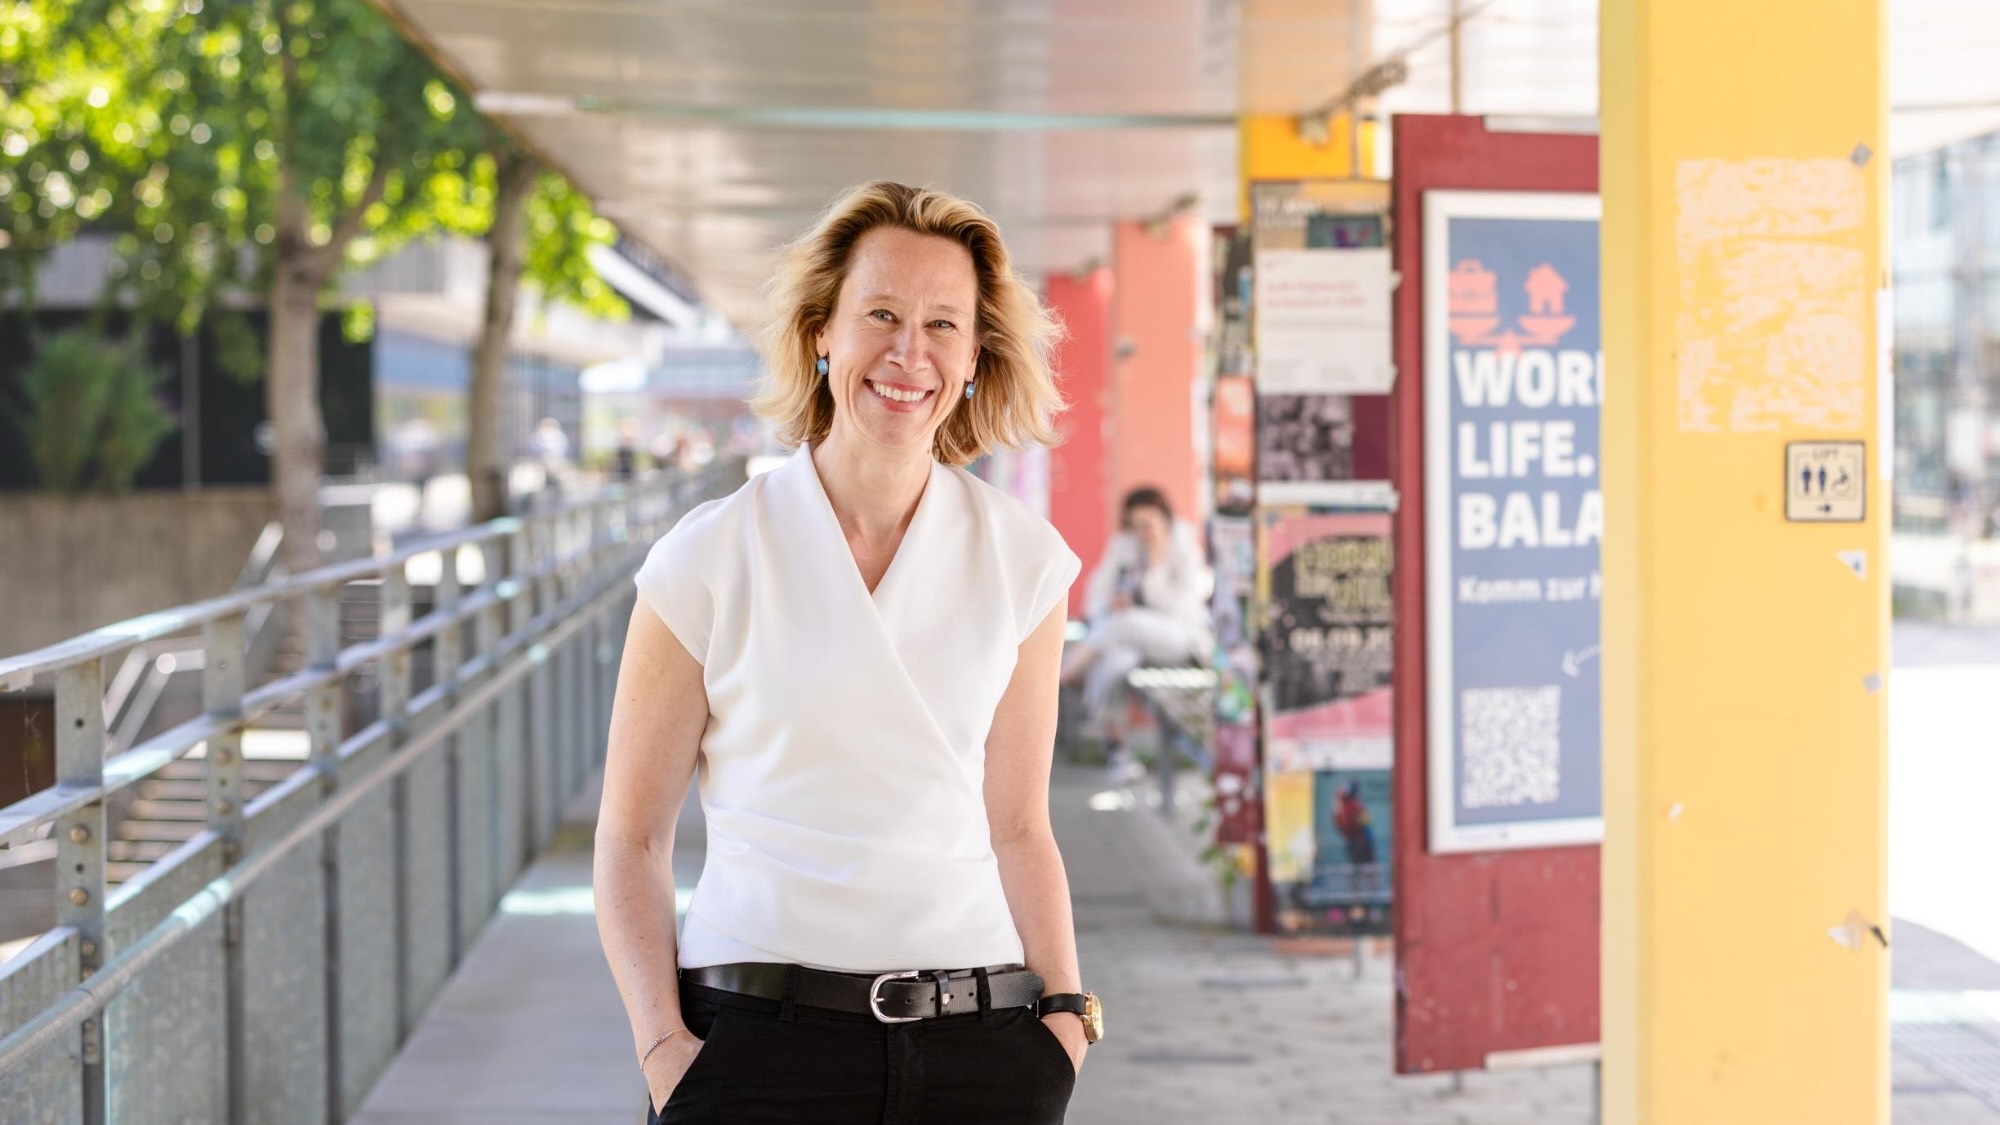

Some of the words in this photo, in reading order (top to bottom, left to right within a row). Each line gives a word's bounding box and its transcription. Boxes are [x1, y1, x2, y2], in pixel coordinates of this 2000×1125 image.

[1453, 350, 1604, 408] WOR
[1457, 420, 1596, 478] LIFE.
[1812, 448, 1839, 461] LIFT
[1458, 575, 1541, 605] Komm
[1546, 577, 1585, 602] zur
